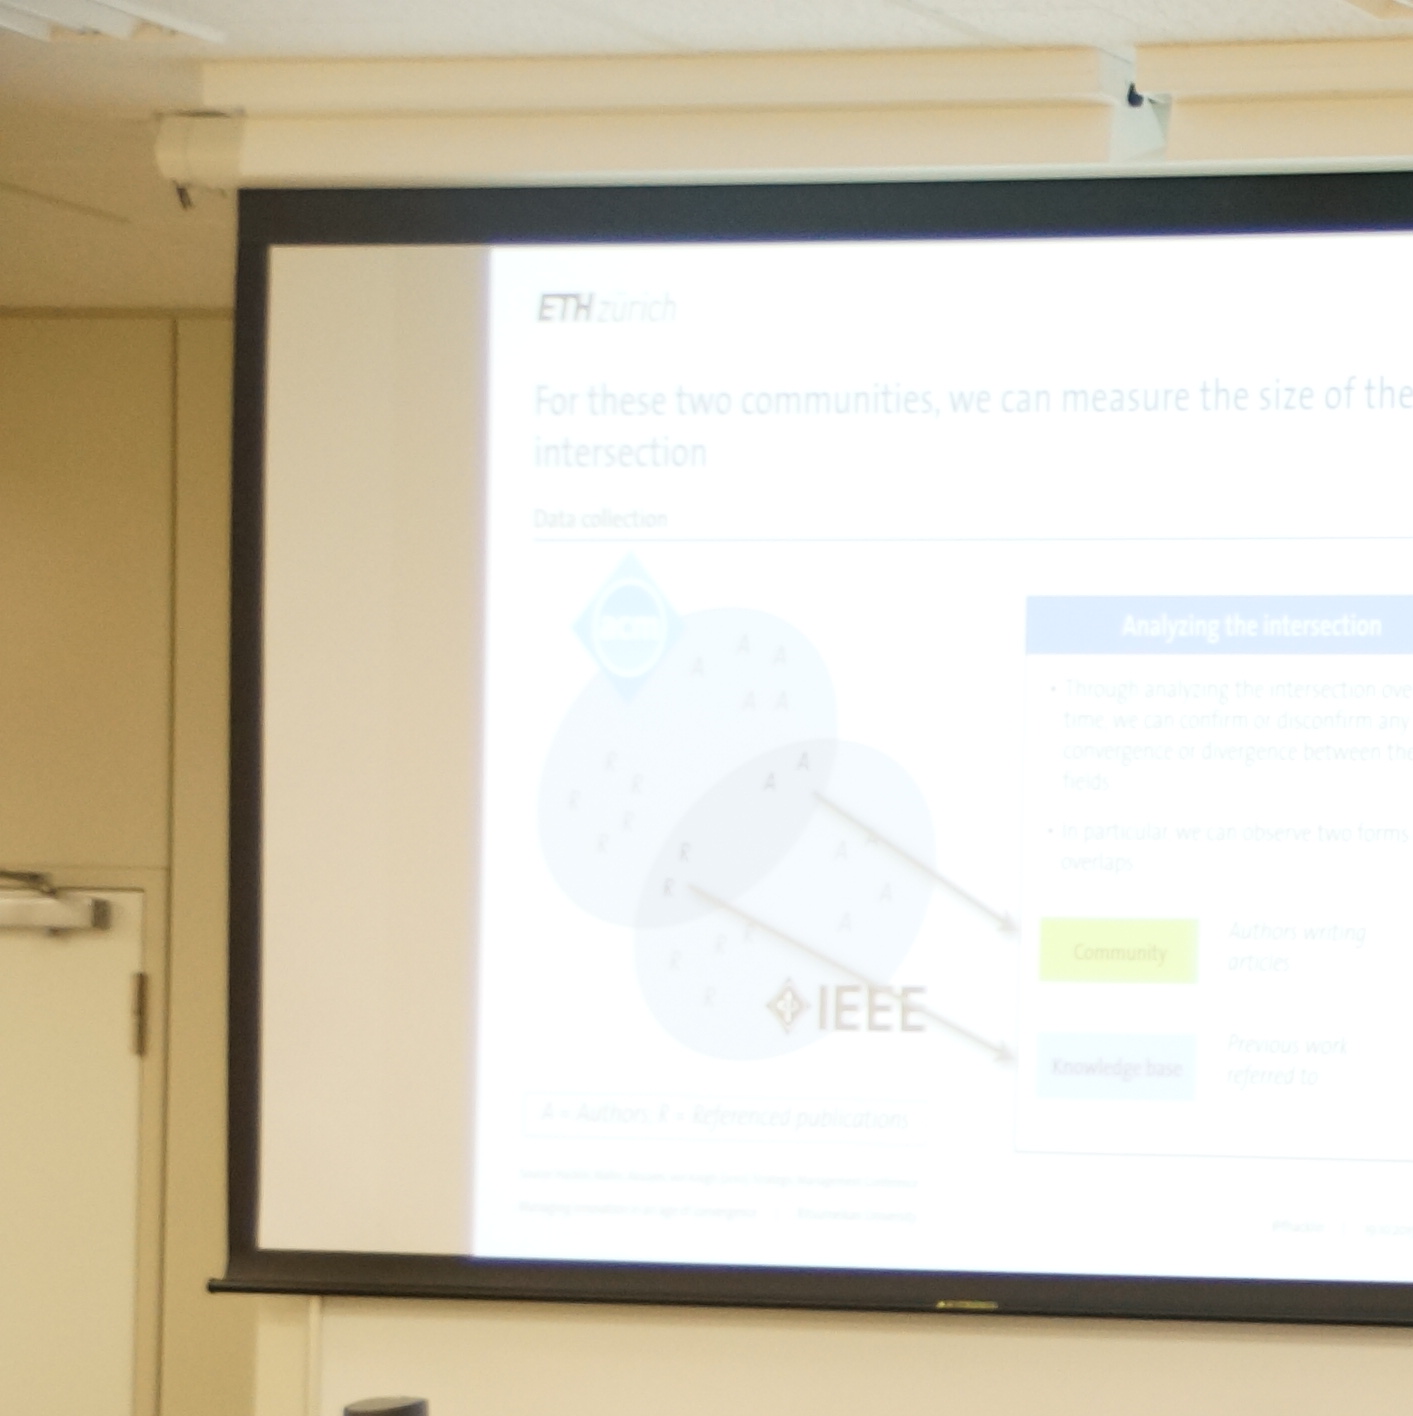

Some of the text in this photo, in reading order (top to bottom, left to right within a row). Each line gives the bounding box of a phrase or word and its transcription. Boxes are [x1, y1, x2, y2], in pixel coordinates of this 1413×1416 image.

[535, 375, 1413, 418] For these two communities, we can measure the size of the
[535, 436, 707, 467] intersection
[533, 506, 668, 529] Data collection
[1122, 613, 1383, 644] Analyzing the intersection
[1073, 942, 1168, 968] Community
[817, 983, 928, 1034] IEEE
[1051, 1056, 1184, 1083] Knowledge base
